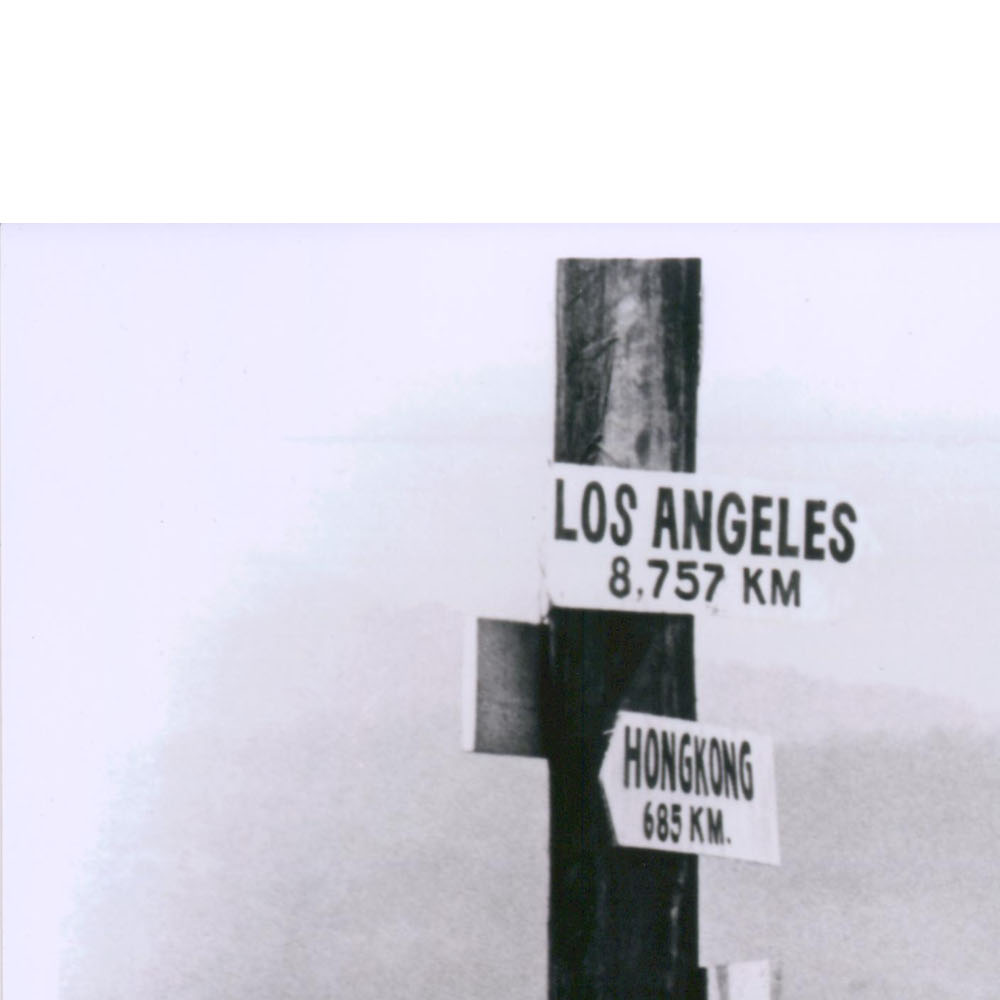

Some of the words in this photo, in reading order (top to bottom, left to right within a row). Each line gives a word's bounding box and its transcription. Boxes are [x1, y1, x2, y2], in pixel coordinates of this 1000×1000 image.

[554, 478, 638, 547] LOS
[651, 486, 858, 564] ANGELES
[742, 566, 802, 608] KM
[622, 725, 755, 802] HONGKONG
[643, 801, 682, 844] 685
[689, 805, 732, 845] KM.
